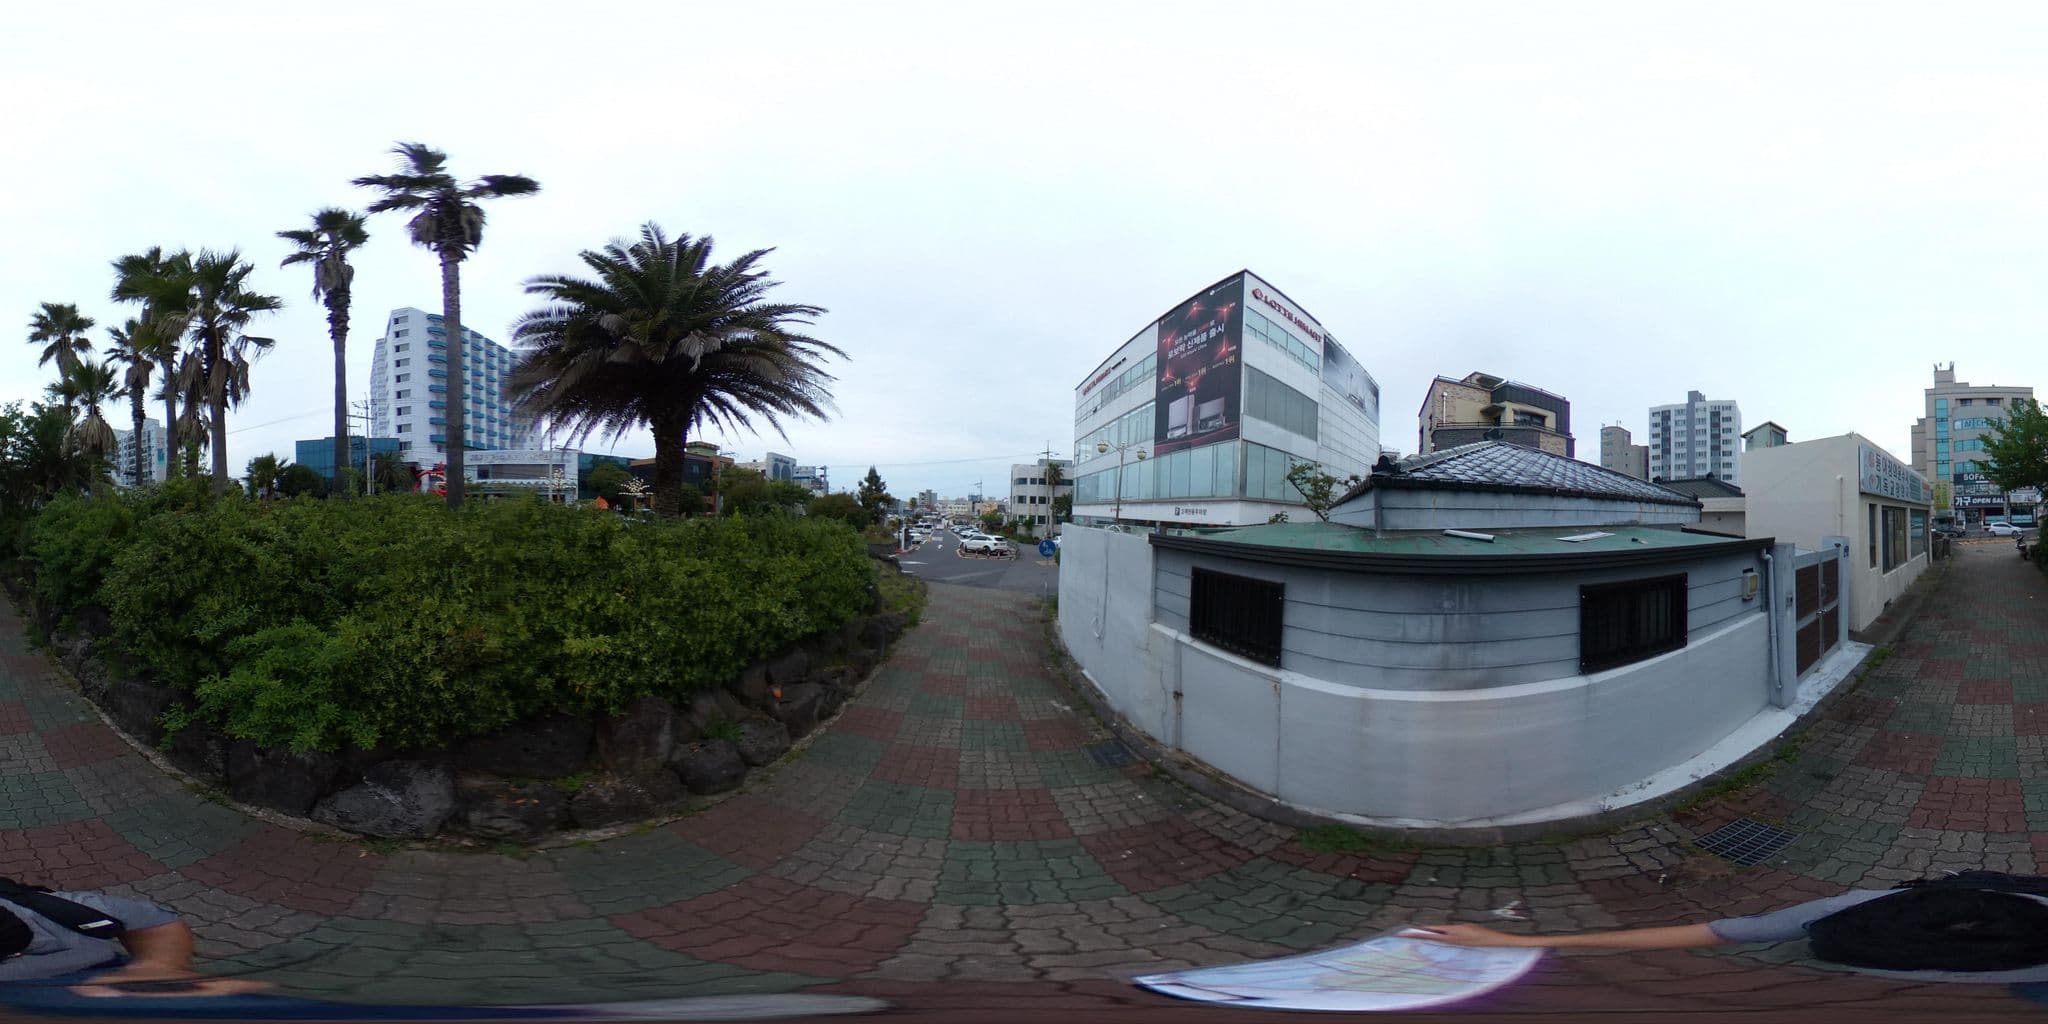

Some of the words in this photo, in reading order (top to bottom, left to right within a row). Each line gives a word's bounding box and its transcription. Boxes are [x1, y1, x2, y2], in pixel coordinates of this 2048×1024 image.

[1264, 295, 1293, 321] LOTTE
[1209, 323, 1225, 338] 출시
[1963, 473, 1985, 481] SOFA
[1955, 496, 1971, 507] 가구
